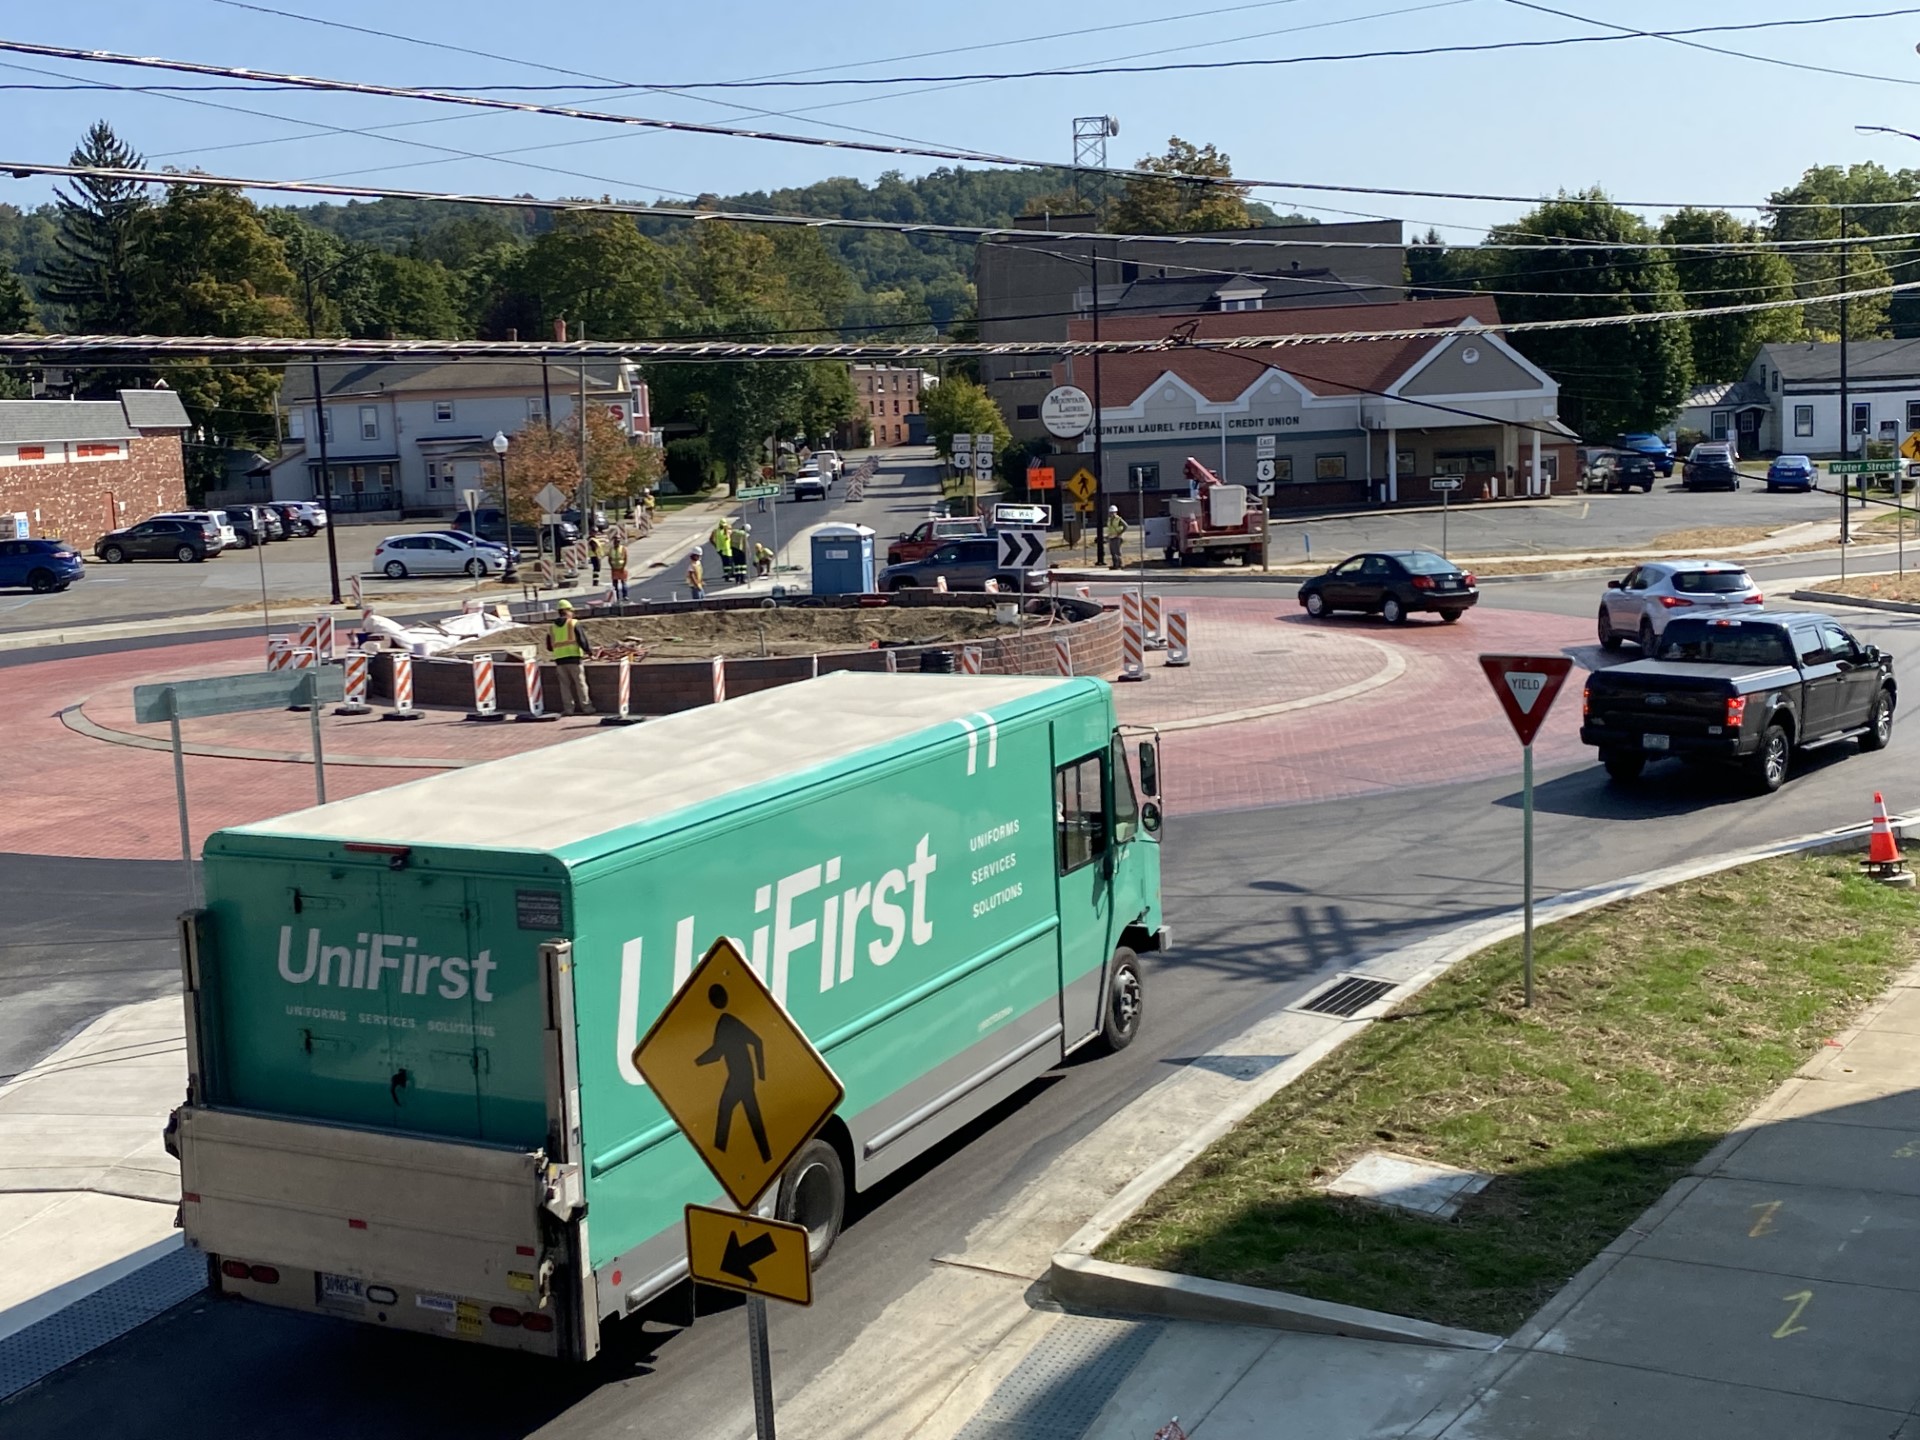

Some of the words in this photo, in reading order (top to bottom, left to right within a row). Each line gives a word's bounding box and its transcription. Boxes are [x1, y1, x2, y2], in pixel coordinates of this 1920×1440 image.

[1138, 422, 1175, 433] LAUREL
[1179, 420, 1222, 431] FEDERAL
[1228, 418, 1264, 428] CREDIT
[1267, 416, 1300, 426] UNION
[959, 455, 966, 465] 6
[981, 455, 988, 465] 6
[1262, 464, 1270, 476] 6
[1832, 463, 1862, 472] Water
[1866, 461, 1896, 471] Street
[1512, 678, 1540, 690] YIELD
[970, 819, 1019, 852] UNIFORMS
[971, 852, 1017, 886] SERVICES
[972, 882, 1023, 918] SOLUTIONS
[278, 925, 498, 1002] UniFirst
[617, 833, 937, 1086] UiFirst
[285, 1004, 347, 1022] UNIFORMS
[358, 1013, 416, 1029] SERVICES
[427, 1019, 496, 1038] SOLUTIONS
